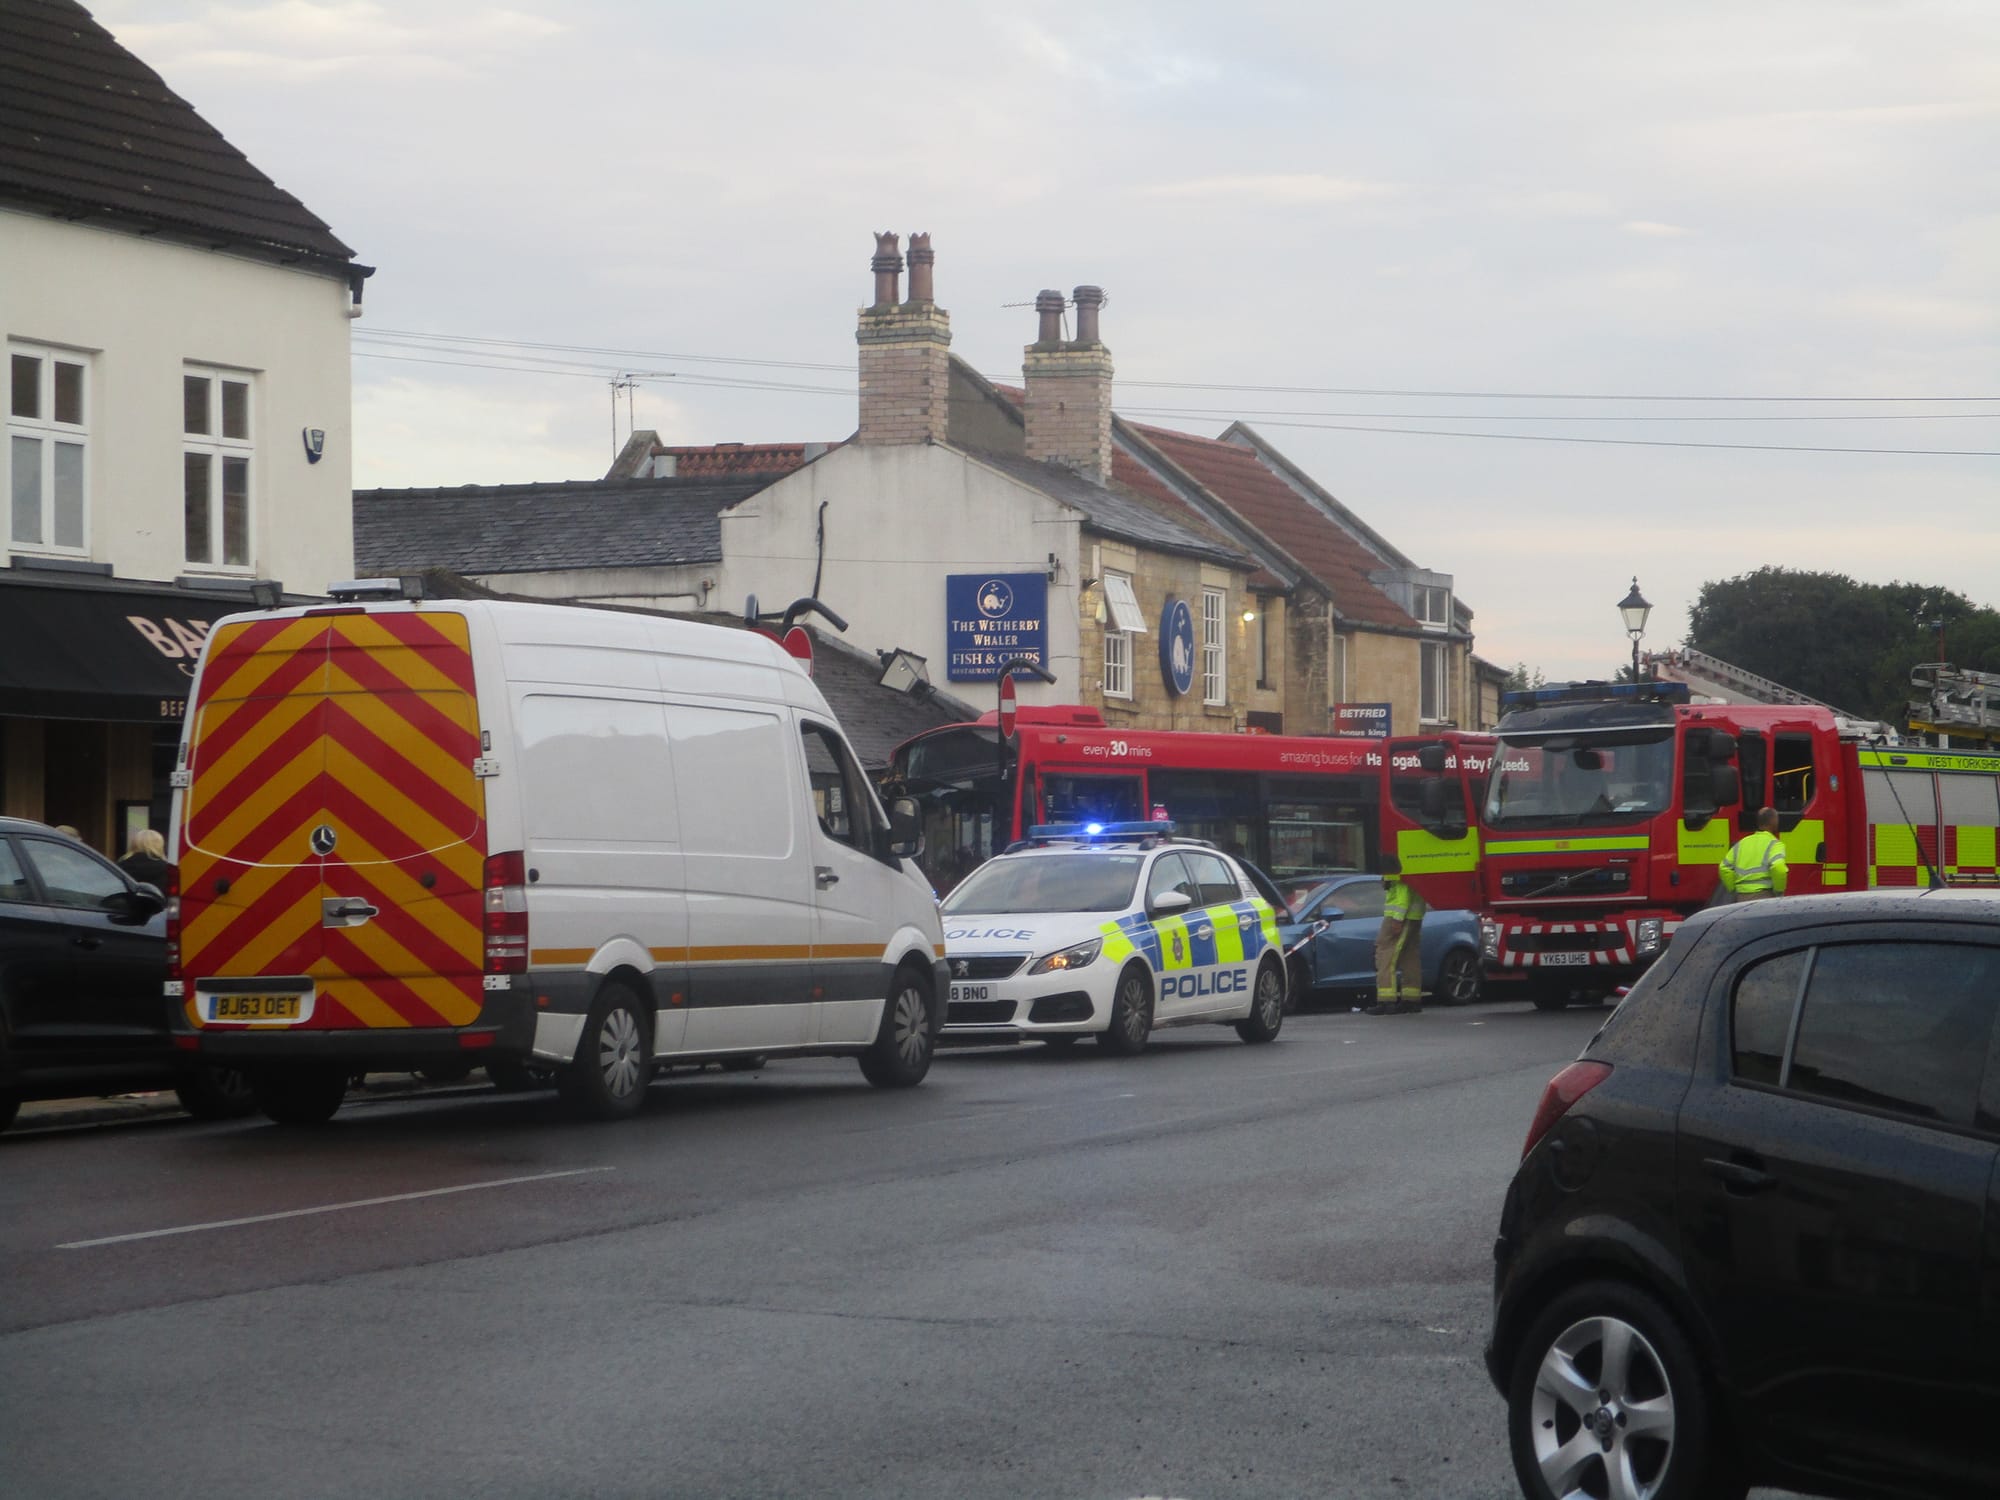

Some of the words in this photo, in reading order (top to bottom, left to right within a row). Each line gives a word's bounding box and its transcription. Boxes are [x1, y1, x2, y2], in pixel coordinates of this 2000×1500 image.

[952, 620, 976, 632] THE
[978, 619, 1040, 632] WETHERBY
[973, 634, 1018, 646] WHALER
[952, 653, 982, 665] FISH
[985, 652, 996, 665] &
[1340, 708, 1387, 718] BETFRED
[1367, 728, 1387, 737] king
[1082, 745, 1110, 759] every
[1110, 740, 1128, 756] 30
[1129, 745, 1153, 757] mins
[1280, 751, 1320, 767] amazing
[1321, 750, 1349, 765] buses
[1350, 751, 1363, 765] for
[1501, 756, 1530, 772] Leeds
[1927, 756, 1952, 768] WEST
[944, 928, 1037, 941] OLICE
[1543, 953, 1566, 965] YK63
[1160, 968, 1248, 1001] POLICE
[963, 986, 987, 1000] BNO
[220, 998, 260, 1015] BJ63
[265, 997, 298, 1014] OET
